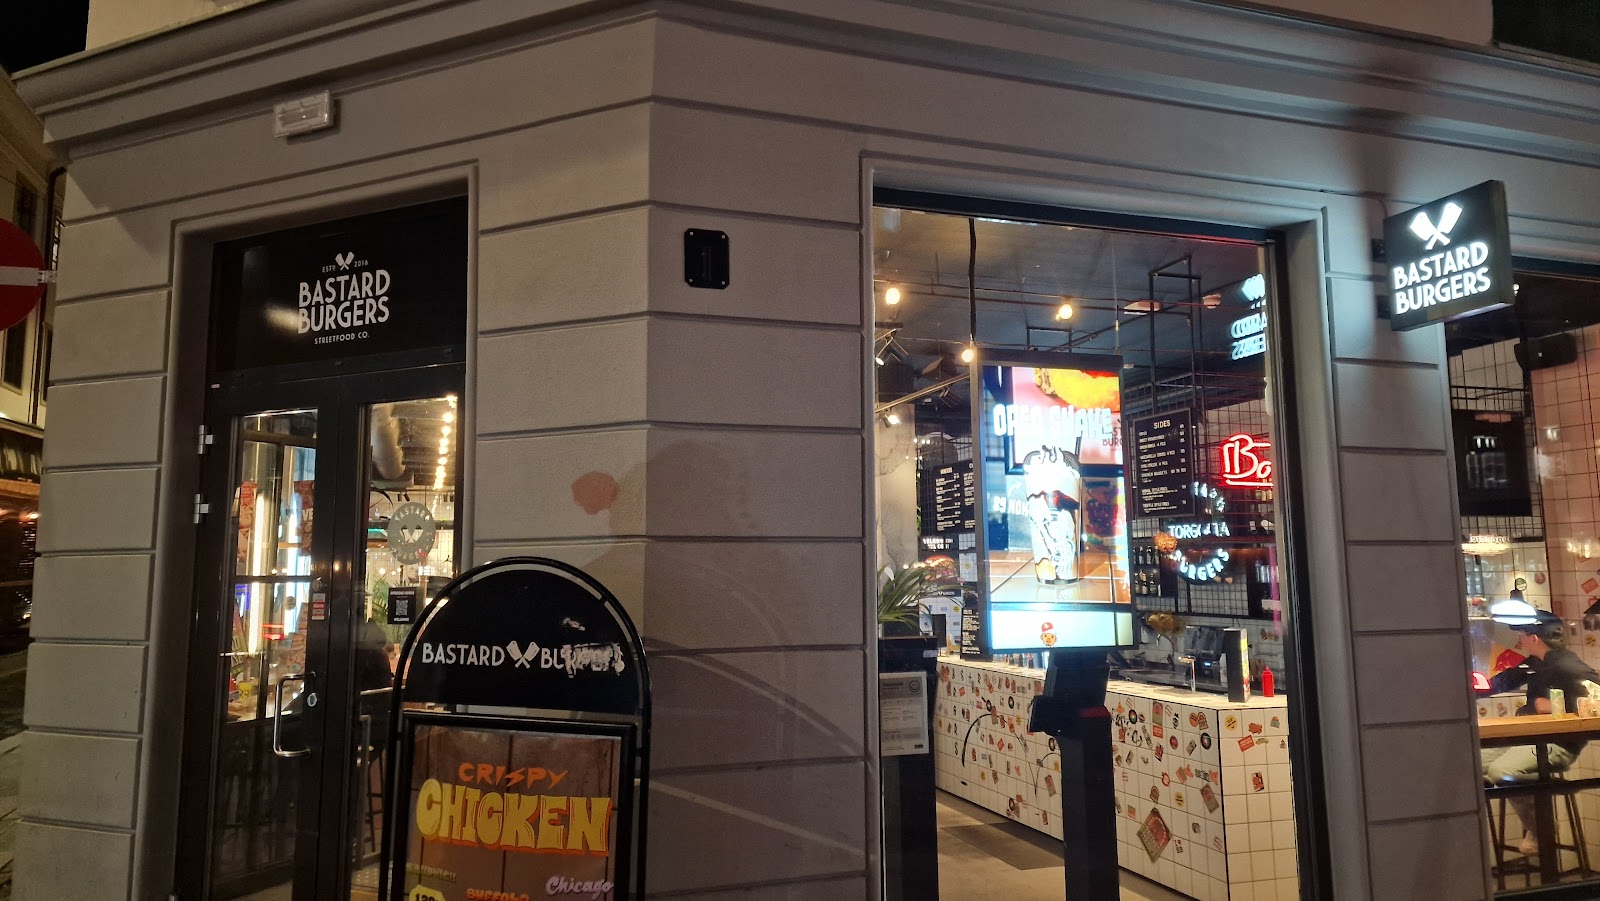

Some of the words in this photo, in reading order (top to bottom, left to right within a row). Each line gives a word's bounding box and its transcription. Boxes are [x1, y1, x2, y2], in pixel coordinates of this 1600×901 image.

[354, 259, 369, 268] 2016
[1392, 241, 1489, 291] BASTARD
[299, 269, 391, 308] BASTARD
[1394, 267, 1492, 315] BURGERS
[297, 295, 390, 335] BURGERS
[314, 333, 356, 345] STREETFOOD
[1153, 419, 1171, 430] SIDES
[422, 642, 505, 667] BASTARD
[458, 762, 568, 789] CRISPY
[416, 778, 613, 855] CHICKEN
[545, 875, 615, 900] Chicago
